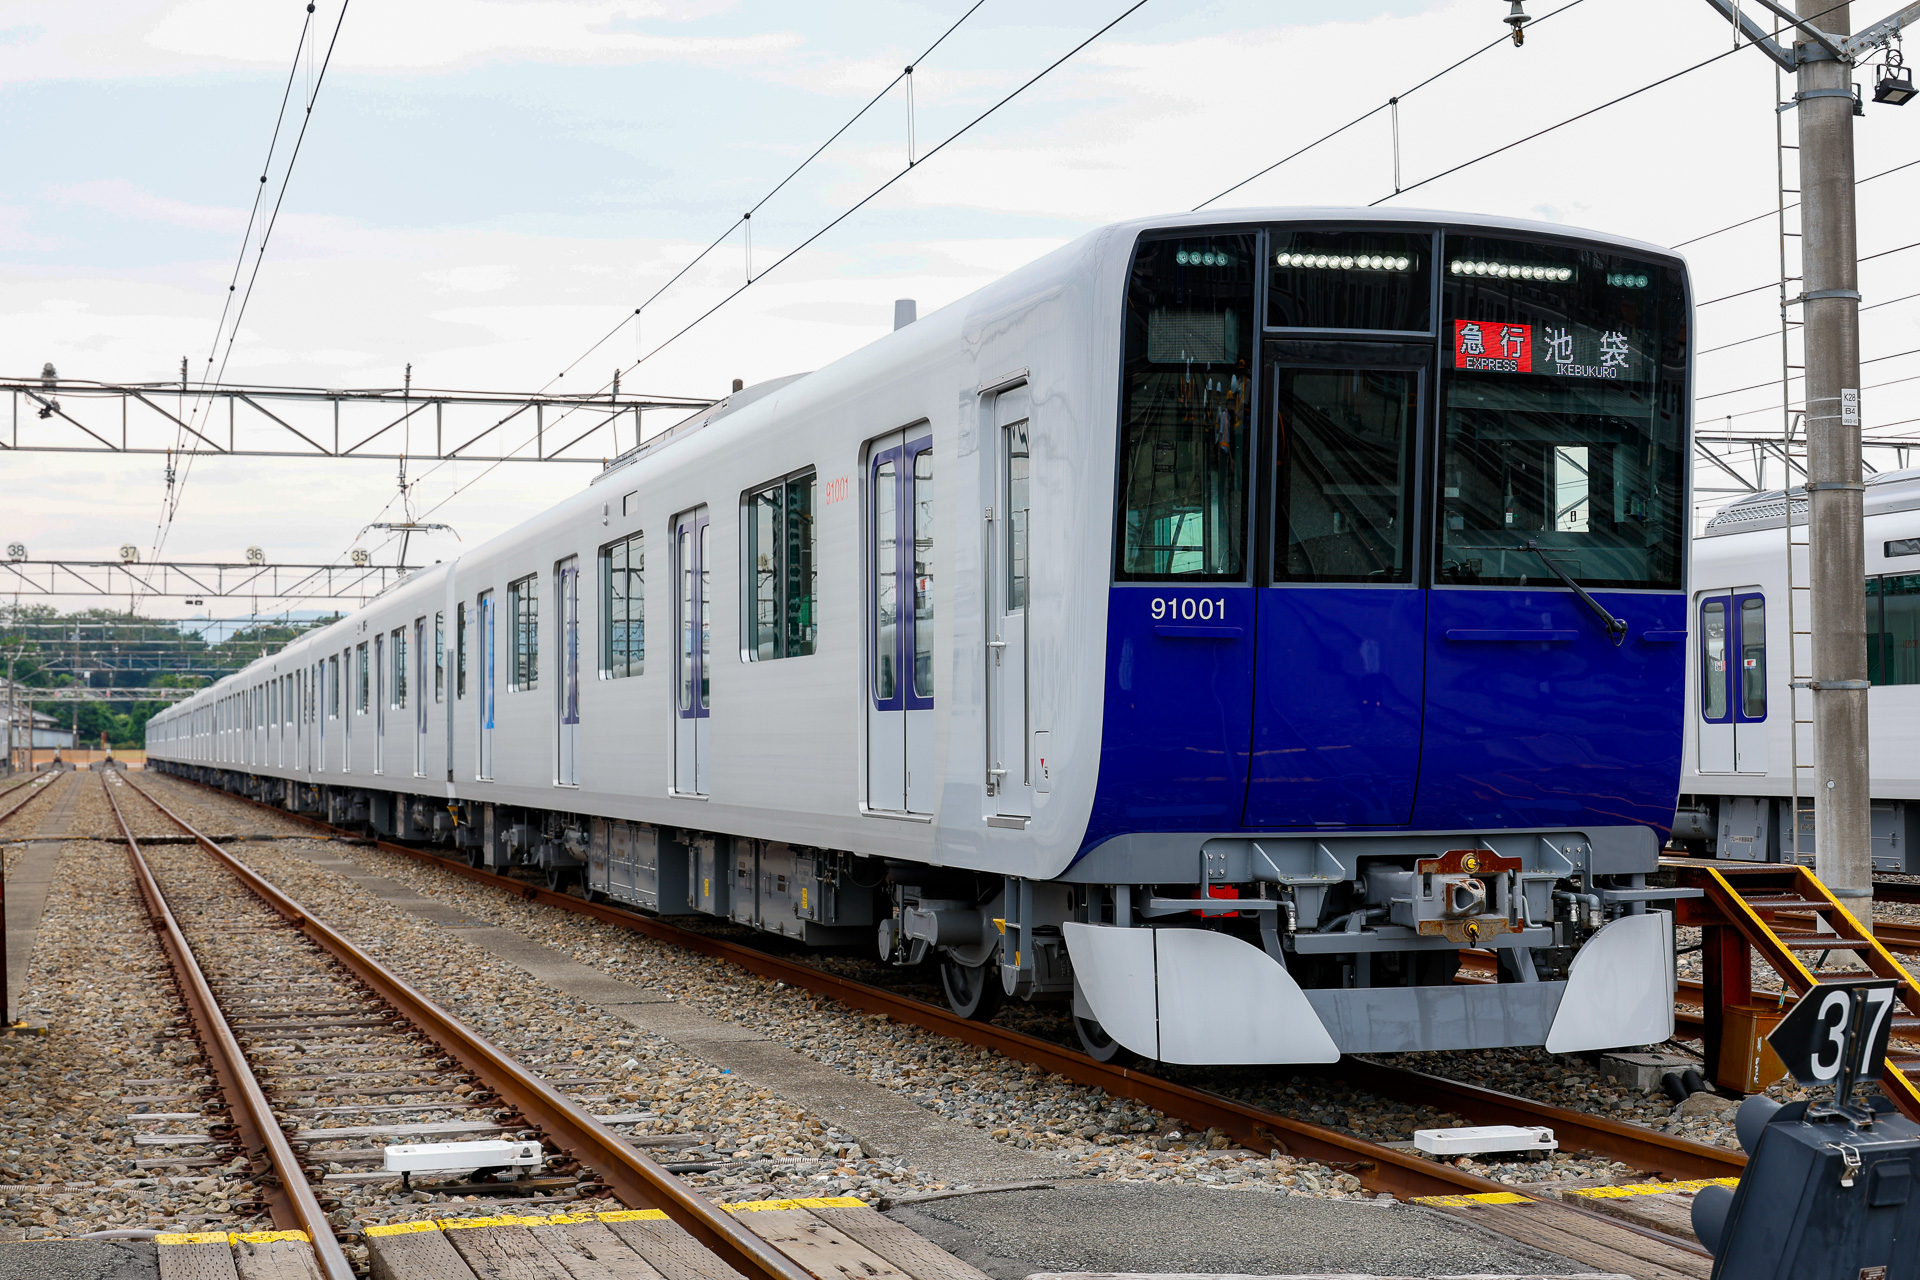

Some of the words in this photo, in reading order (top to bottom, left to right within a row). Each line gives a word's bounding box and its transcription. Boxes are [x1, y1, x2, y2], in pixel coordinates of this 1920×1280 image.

[1460, 323, 1524, 358] 急行
[1544, 326, 1629, 368] 池袋
[1466, 357, 1518, 371] EXPRESS
[1556, 363, 1617, 378] IKEBUKURO
[1844, 393, 1856, 401] K28
[825, 475, 849, 505] 91001
[7, 544, 25, 557] 38
[120, 546, 137, 559] 37
[246, 548, 263, 561] 36
[352, 550, 368, 562] 35
[1151, 597, 1225, 620] 91001
[1811, 987, 1895, 1080] 37
